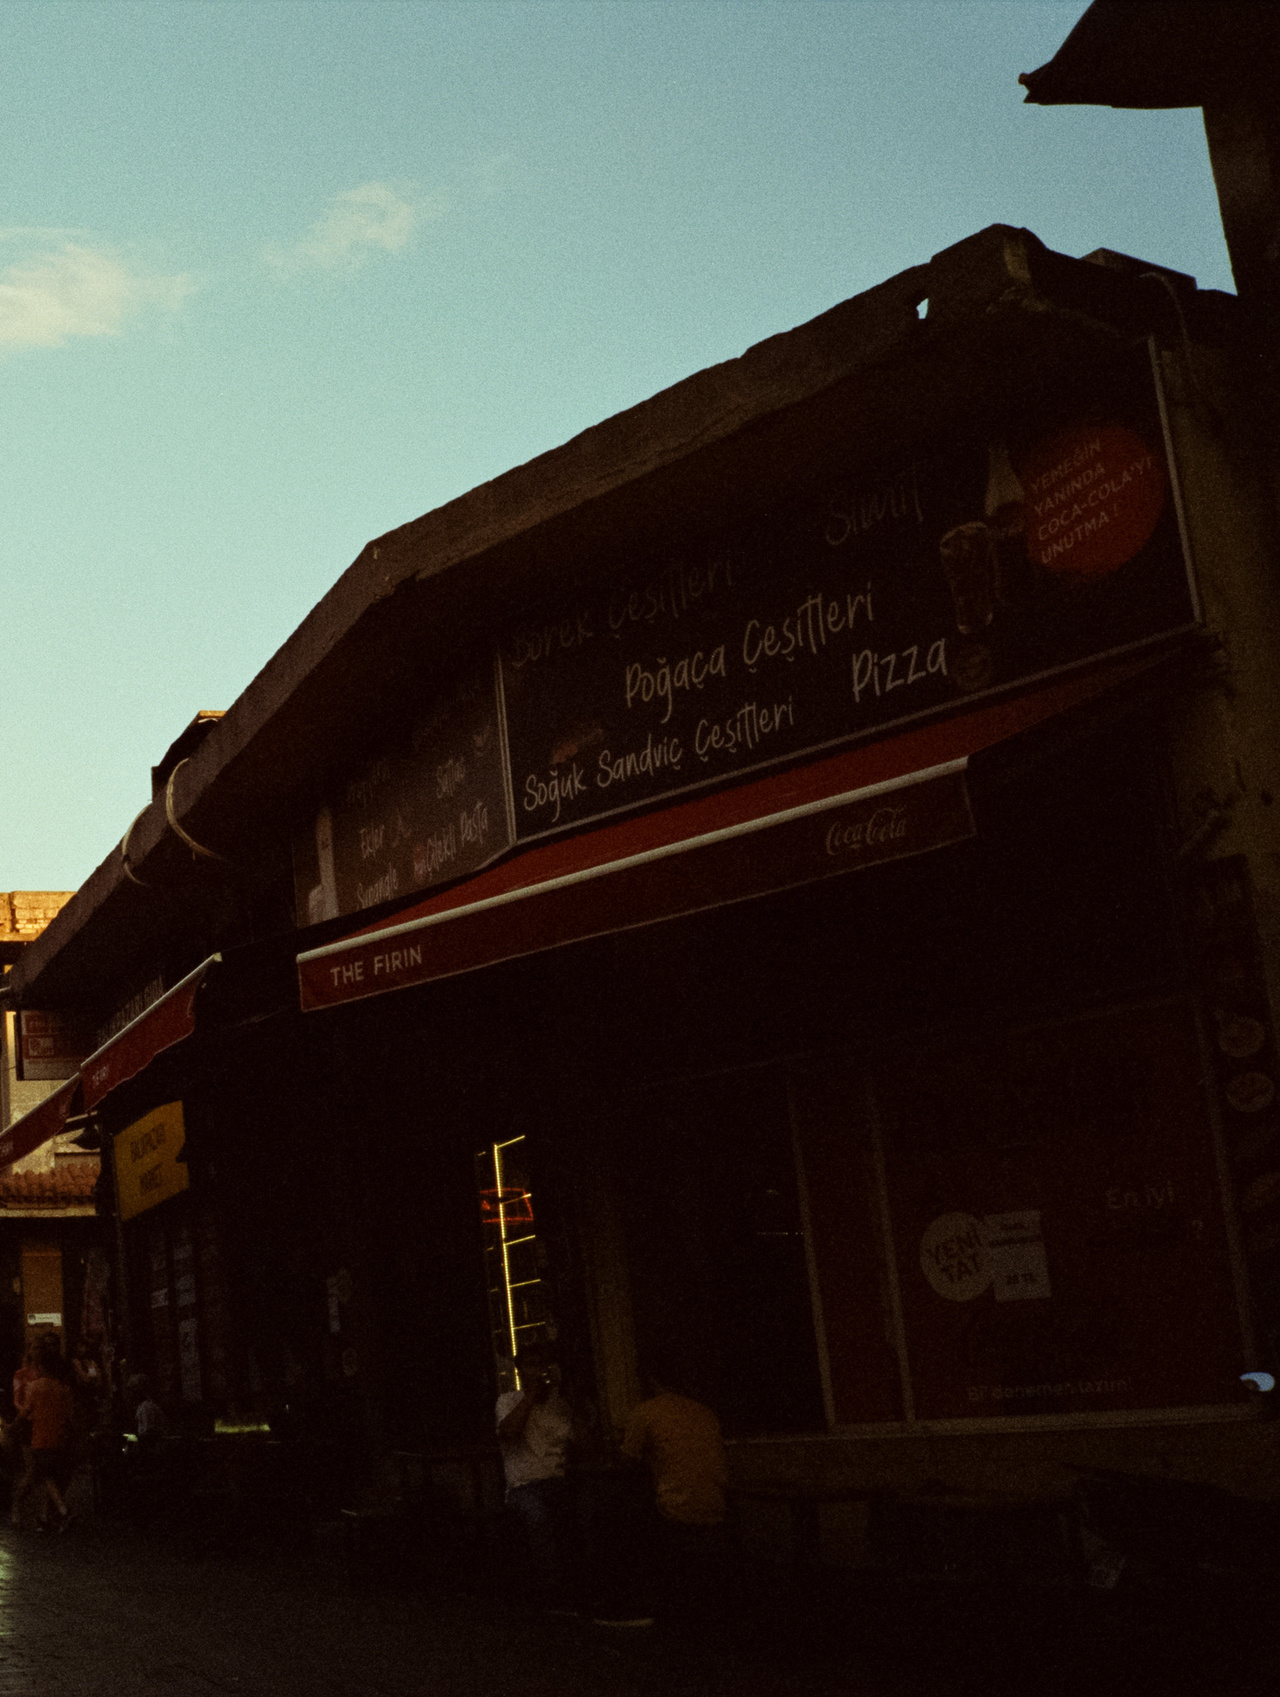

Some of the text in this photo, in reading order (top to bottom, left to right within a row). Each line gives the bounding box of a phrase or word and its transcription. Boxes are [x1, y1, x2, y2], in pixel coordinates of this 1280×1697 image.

[1033, 462, 1106, 517] YANINDA
[625, 642, 727, 723] Poğaça
[743, 582, 875, 680] Çeşitleri
[851, 637, 949, 703] Pizza
[523, 763, 587, 822] Soğuk
[596, 736, 683, 790] Sandviç
[695, 696, 794, 763] Çeşitleri
[330, 945, 422, 987] THE FIRIN
[1105, 1186, 1140, 1209] En
[940, 1252, 983, 1285] TAT
